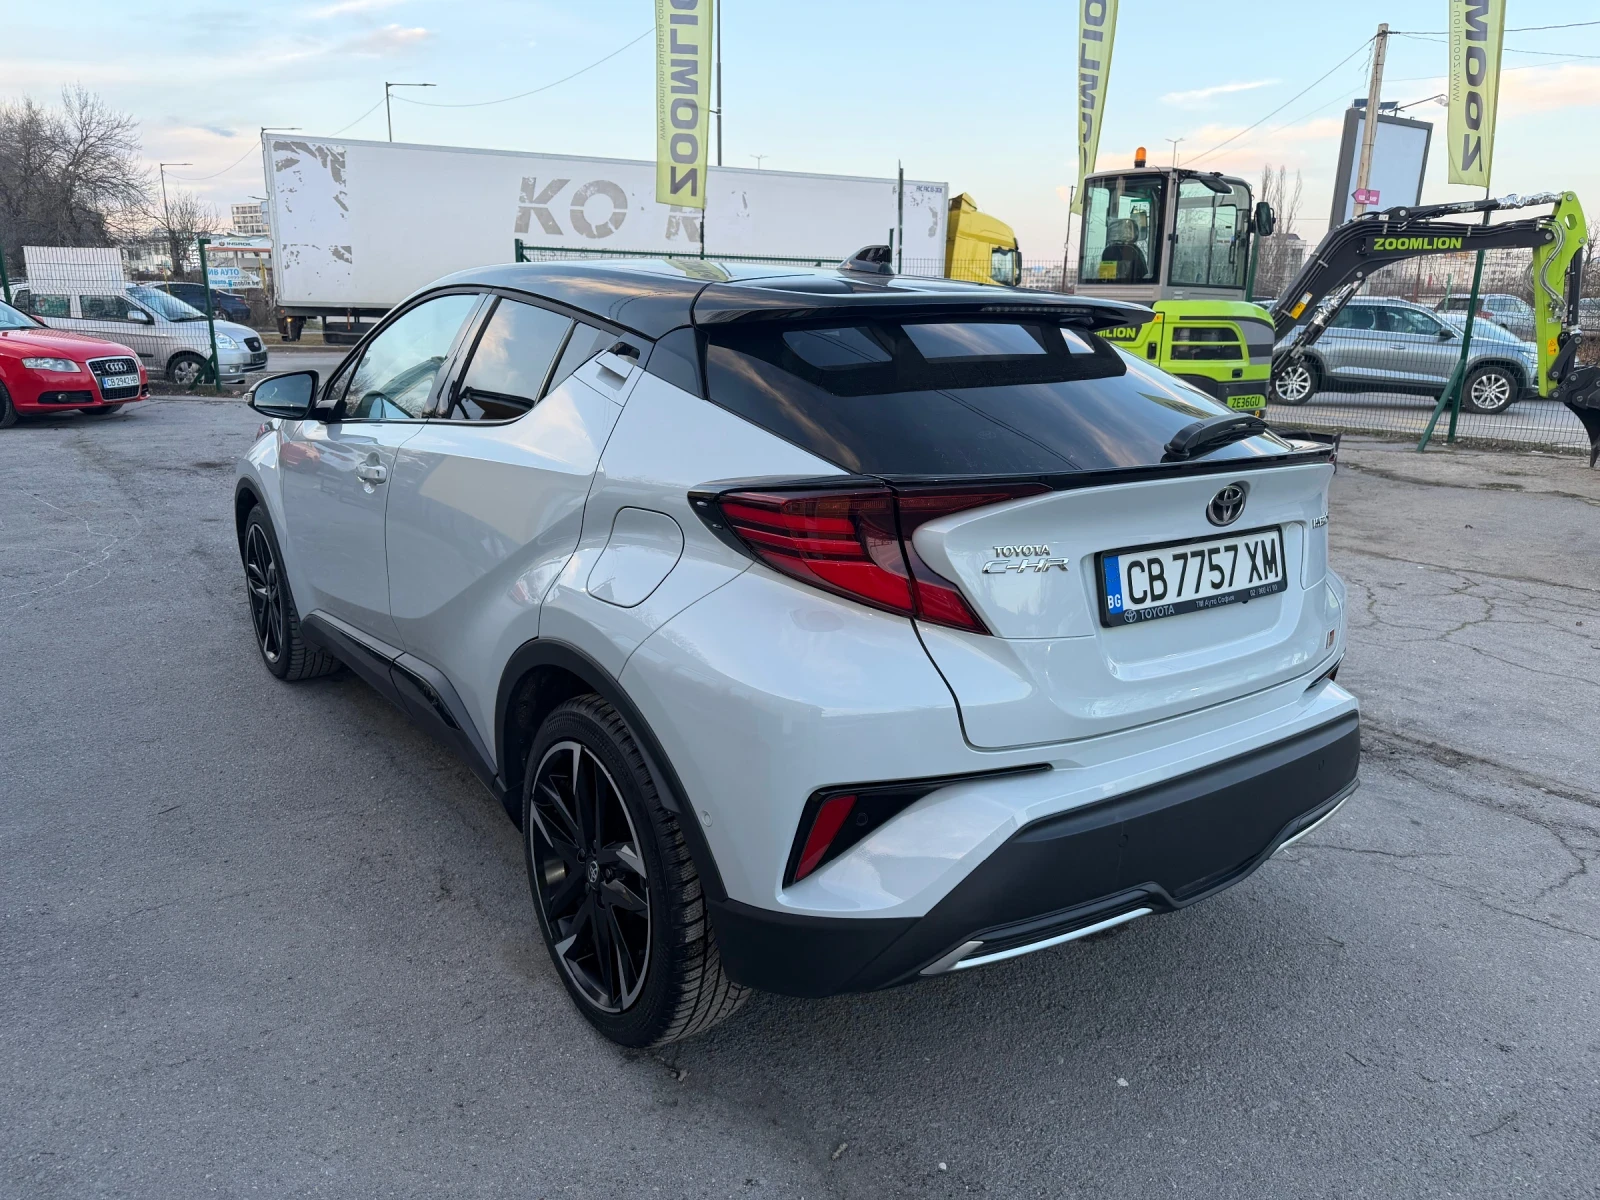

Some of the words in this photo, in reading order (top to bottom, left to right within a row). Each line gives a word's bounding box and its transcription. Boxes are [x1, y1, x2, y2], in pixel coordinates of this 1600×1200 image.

[1373, 237, 1462, 250] ZOOMLION
[1231, 396, 1261, 409] ZE36GU
[993, 544, 1051, 558] TOYOTA
[982, 557, 1069, 574] C-HR
[1126, 556, 1168, 605] CB
[1171, 544, 1239, 598] 7757
[1244, 538, 1280, 583] XM
[1107, 593, 1122, 609] BG
[1140, 604, 1175, 620] TOYOTA
